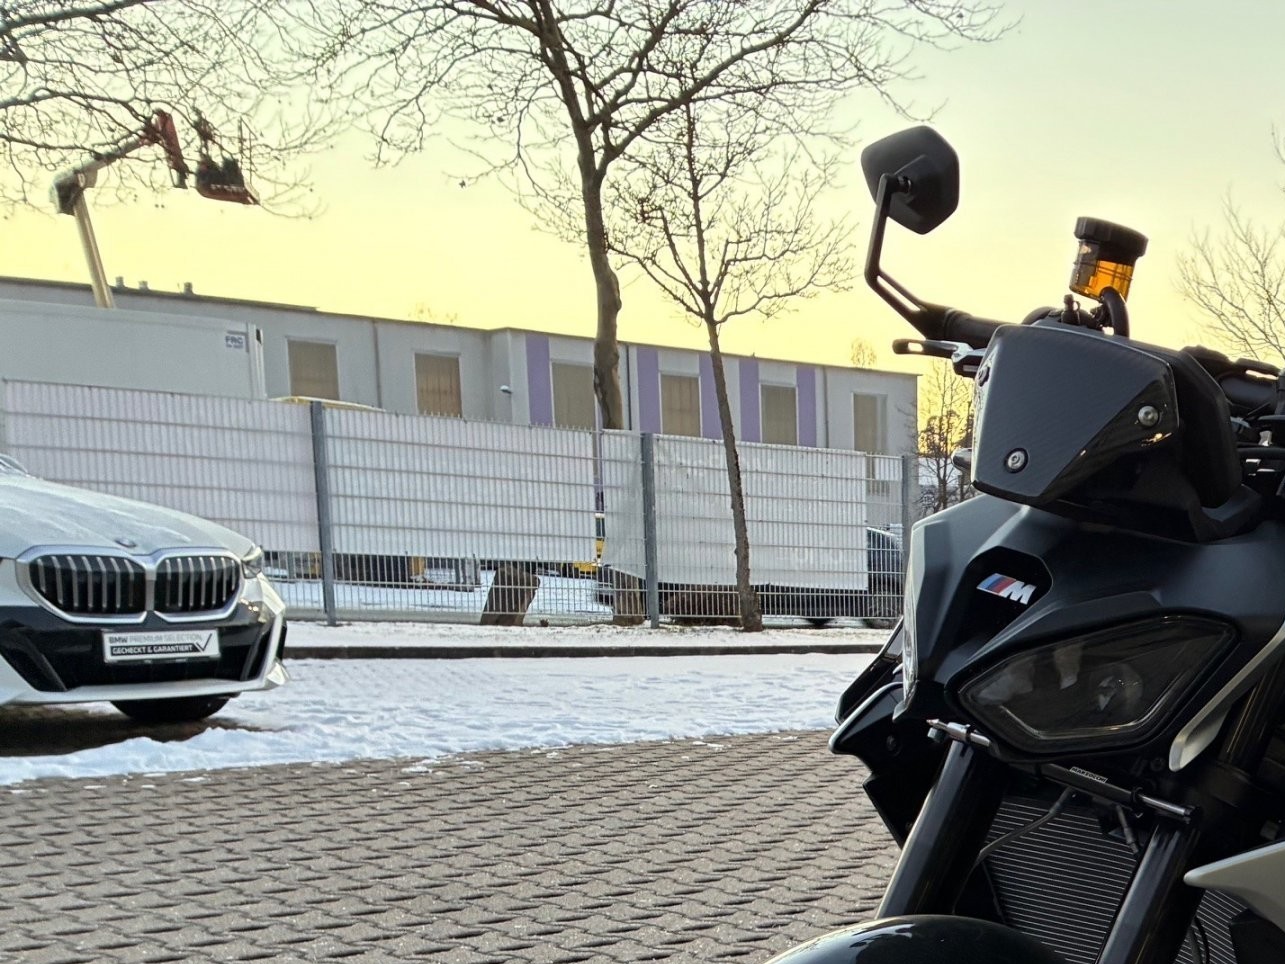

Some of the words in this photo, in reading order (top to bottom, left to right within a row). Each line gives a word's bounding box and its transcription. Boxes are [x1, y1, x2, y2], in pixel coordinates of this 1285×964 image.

[109, 636, 128, 644] BMW
[112, 646, 146, 655] GECHECKT
[153, 644, 193, 653] GARANTIERT
